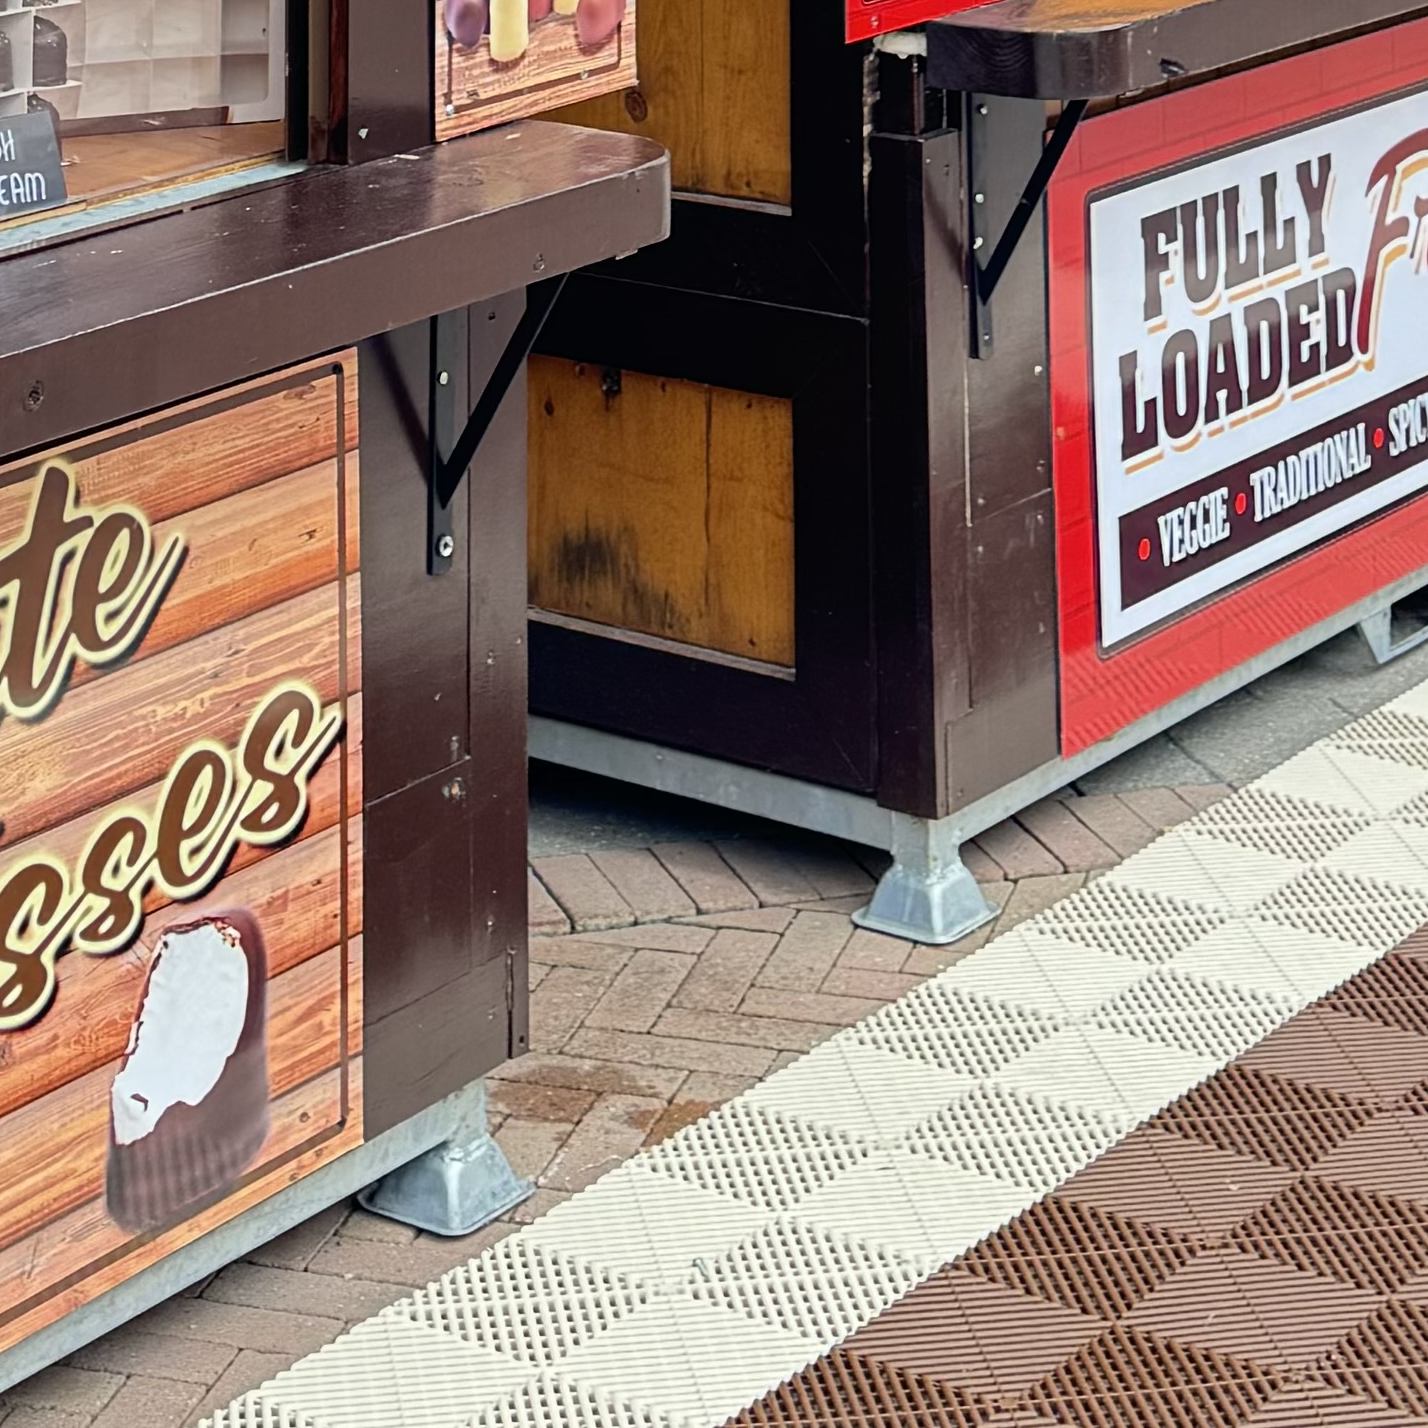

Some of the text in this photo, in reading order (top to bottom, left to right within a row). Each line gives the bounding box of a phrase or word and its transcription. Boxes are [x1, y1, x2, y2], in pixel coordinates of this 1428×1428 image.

[1139, 152, 1338, 334] FULLY
[1117, 266, 1362, 475] LOADED
[1156, 485, 1232, 568] VEGGIE
[1249, 422, 1372, 523] TRADITIONAL
